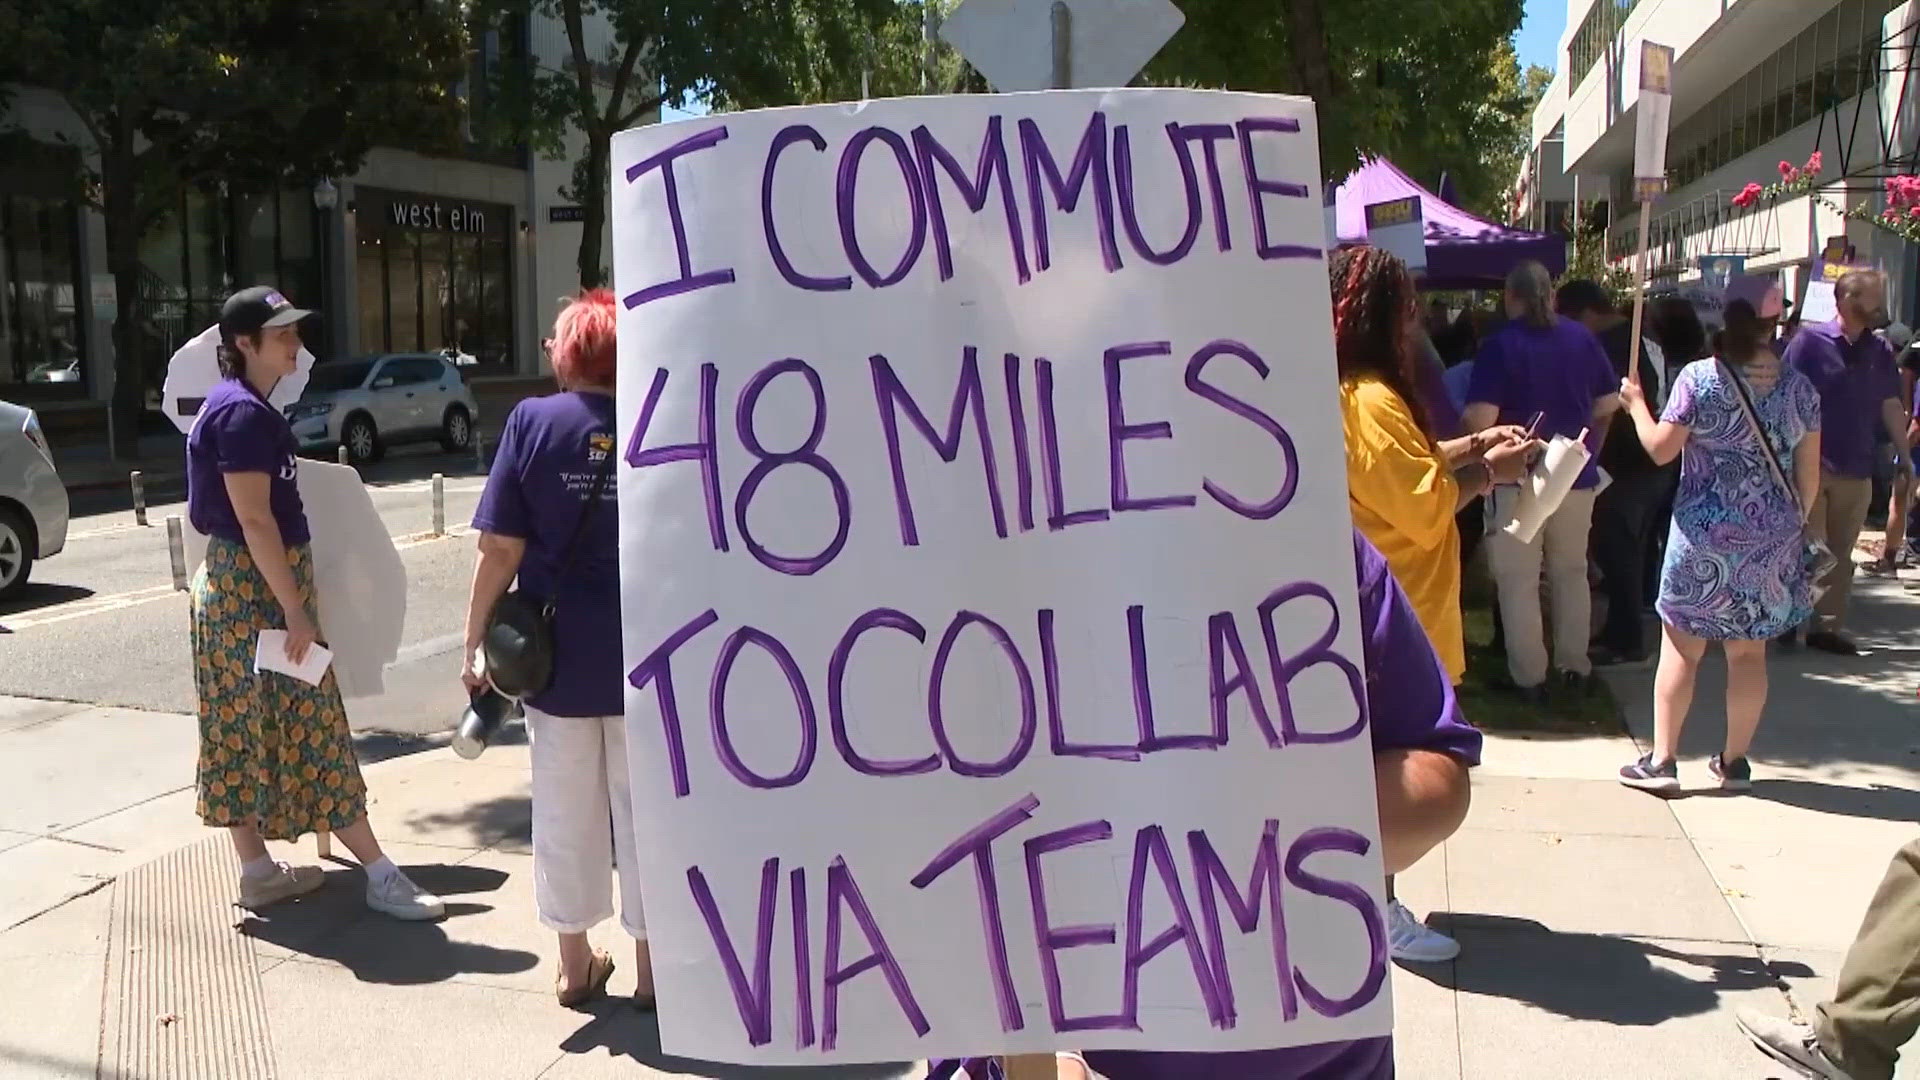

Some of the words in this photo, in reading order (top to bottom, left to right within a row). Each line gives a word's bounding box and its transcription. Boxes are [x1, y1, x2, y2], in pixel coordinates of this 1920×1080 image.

[392, 202, 442, 229] west
[450, 205, 485, 233] elm
[624, 126, 735, 309] I
[762, 111, 1323, 290] COMMUTE
[624, 358, 851, 576] 48
[869, 340, 1299, 547] MILES
[687, 855, 930, 1052] VIA
[910, 793, 1387, 1034] TEAMS
